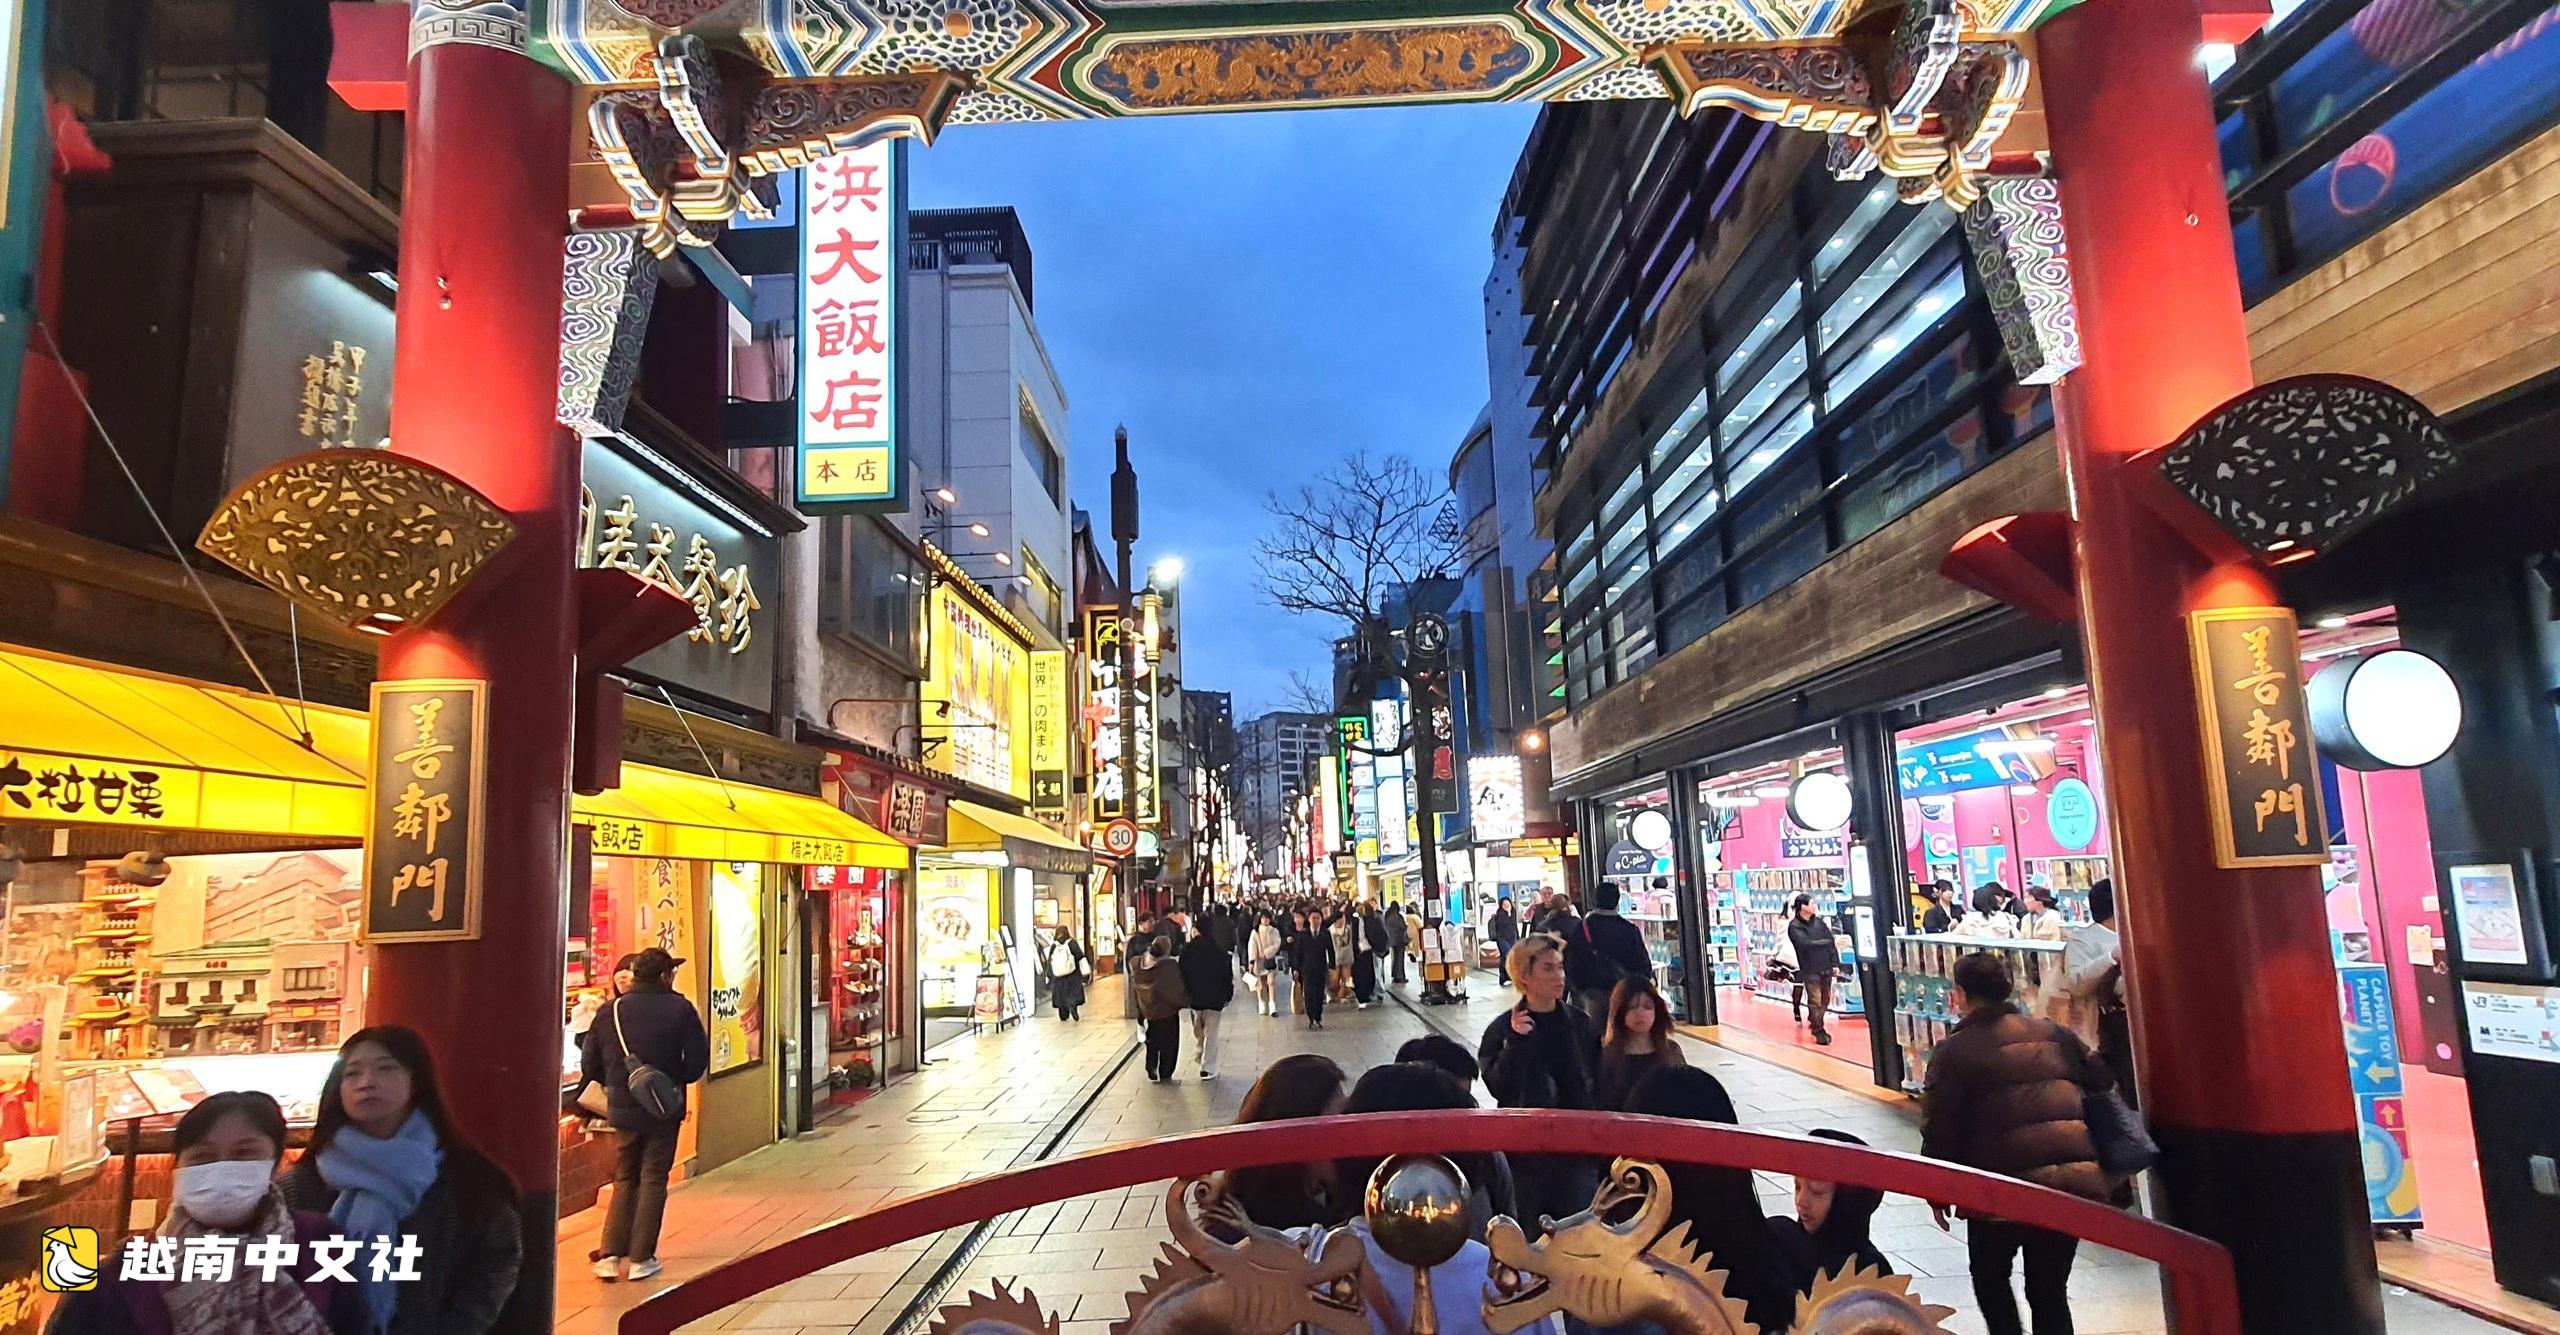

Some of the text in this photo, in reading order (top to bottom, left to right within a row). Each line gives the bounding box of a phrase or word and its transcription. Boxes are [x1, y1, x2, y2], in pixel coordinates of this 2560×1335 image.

[811, 155, 885, 430] 浜大飯店
[815, 459, 877, 483] 本店
[1034, 660, 1047, 763] 世界一の肉まん
[0, 757, 164, 820] 大粒甘栗
[1111, 830, 1131, 846] 30
[2356, 977, 2373, 1025] PLANET
[2371, 977, 2392, 1061] CAPSULE TOY
